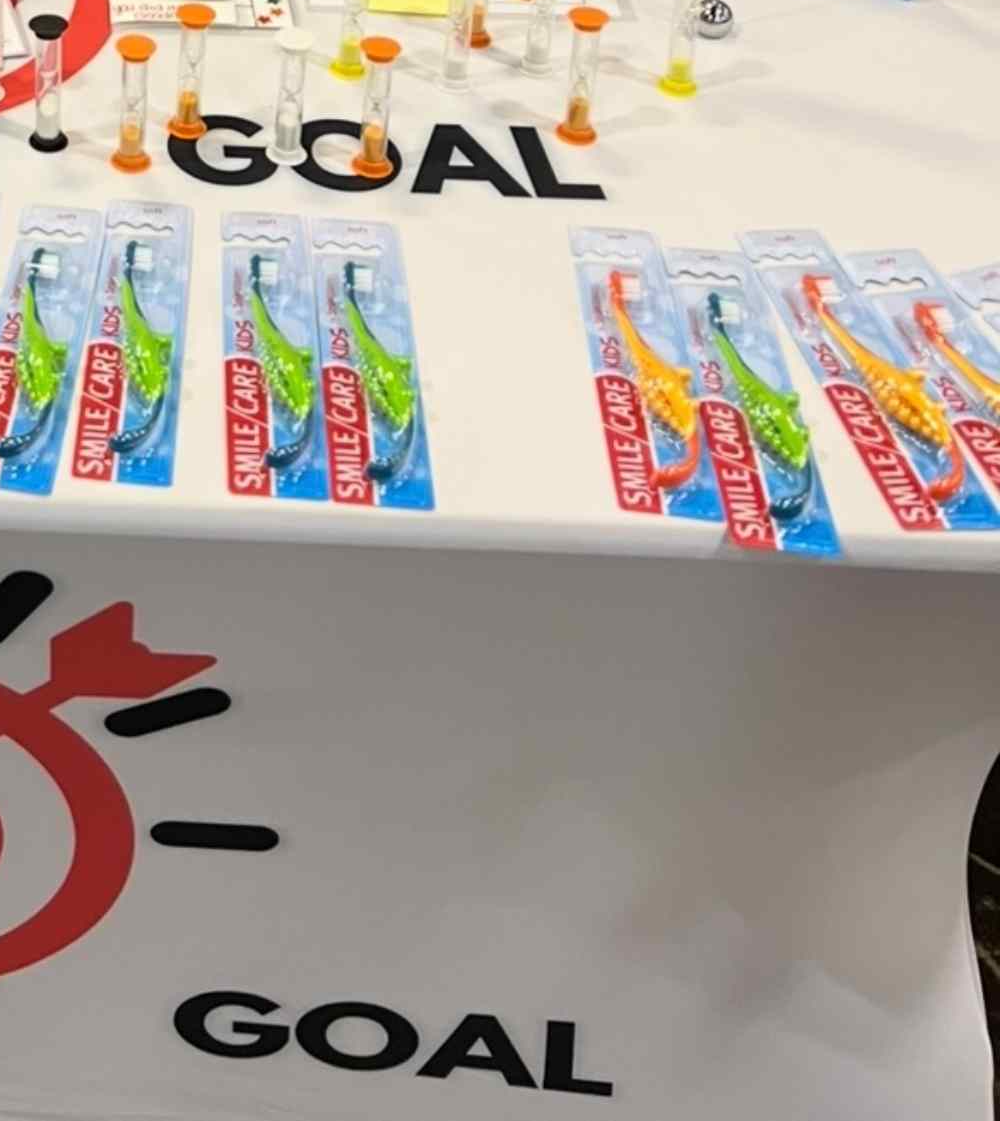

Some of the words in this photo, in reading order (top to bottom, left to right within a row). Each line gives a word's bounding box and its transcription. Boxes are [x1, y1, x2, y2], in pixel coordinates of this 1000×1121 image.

[167, 115, 607, 200] GOAL
[1, 312, 23, 343] KIDS
[101, 305, 121, 337] KIDS
[235, 320, 254, 352] KIDS
[329, 327, 349, 360] KIDS
[603, 336, 620, 369] KIDS
[812, 342, 843, 378] KIDS
[703, 360, 723, 393] KIDS
[934, 376, 968, 413] KIDS
[174, 990, 613, 1097] GOAL
